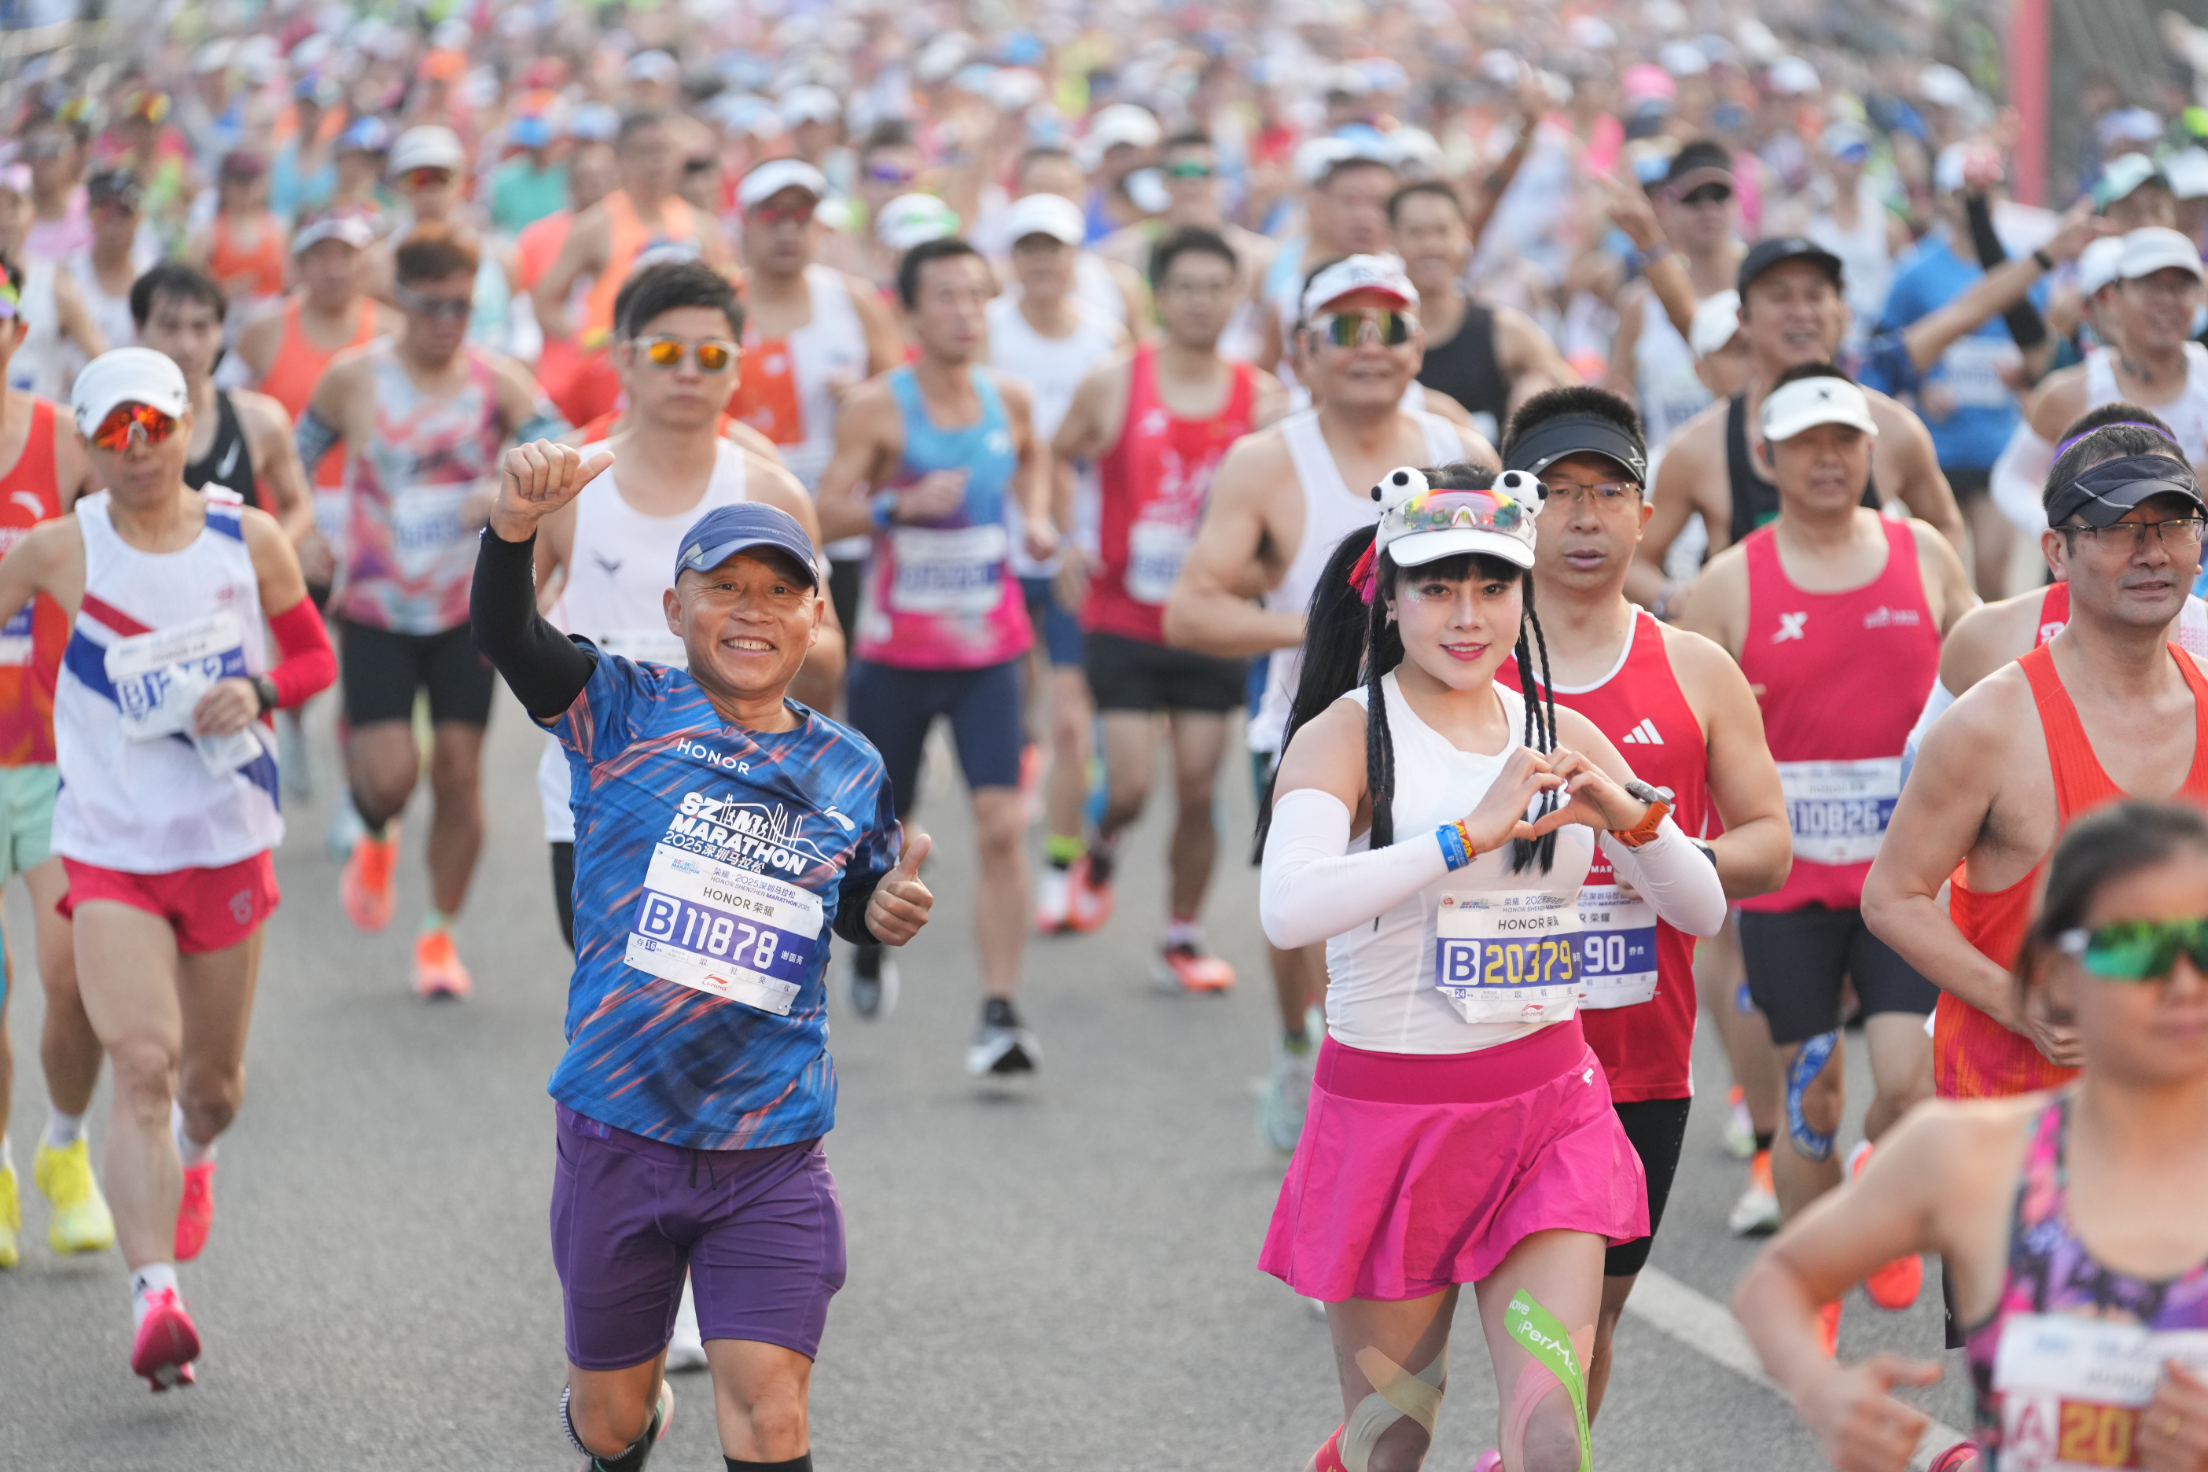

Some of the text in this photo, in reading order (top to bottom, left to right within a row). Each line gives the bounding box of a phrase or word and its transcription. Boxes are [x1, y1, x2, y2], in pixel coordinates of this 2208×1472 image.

[677, 737, 750, 775] HONOR
[662, 830, 765, 875] 2025深圳马拉松
[668, 812, 807, 876] MARATHON
[671, 862, 700, 875] MARATHON
[703, 887, 750, 910] HONOR
[710, 876, 811, 912] HONOR SHENZHEN MARATHON 2025
[752, 902, 775, 918] 荣耀
[644, 898, 778, 970] B 11878
[1498, 917, 1545, 930] HONOR
[645, 940, 656, 951] 16
[1449, 940, 1573, 984] B 20379
[1584, 935, 1625, 973] 90
[1455, 989, 1466, 998] 24
